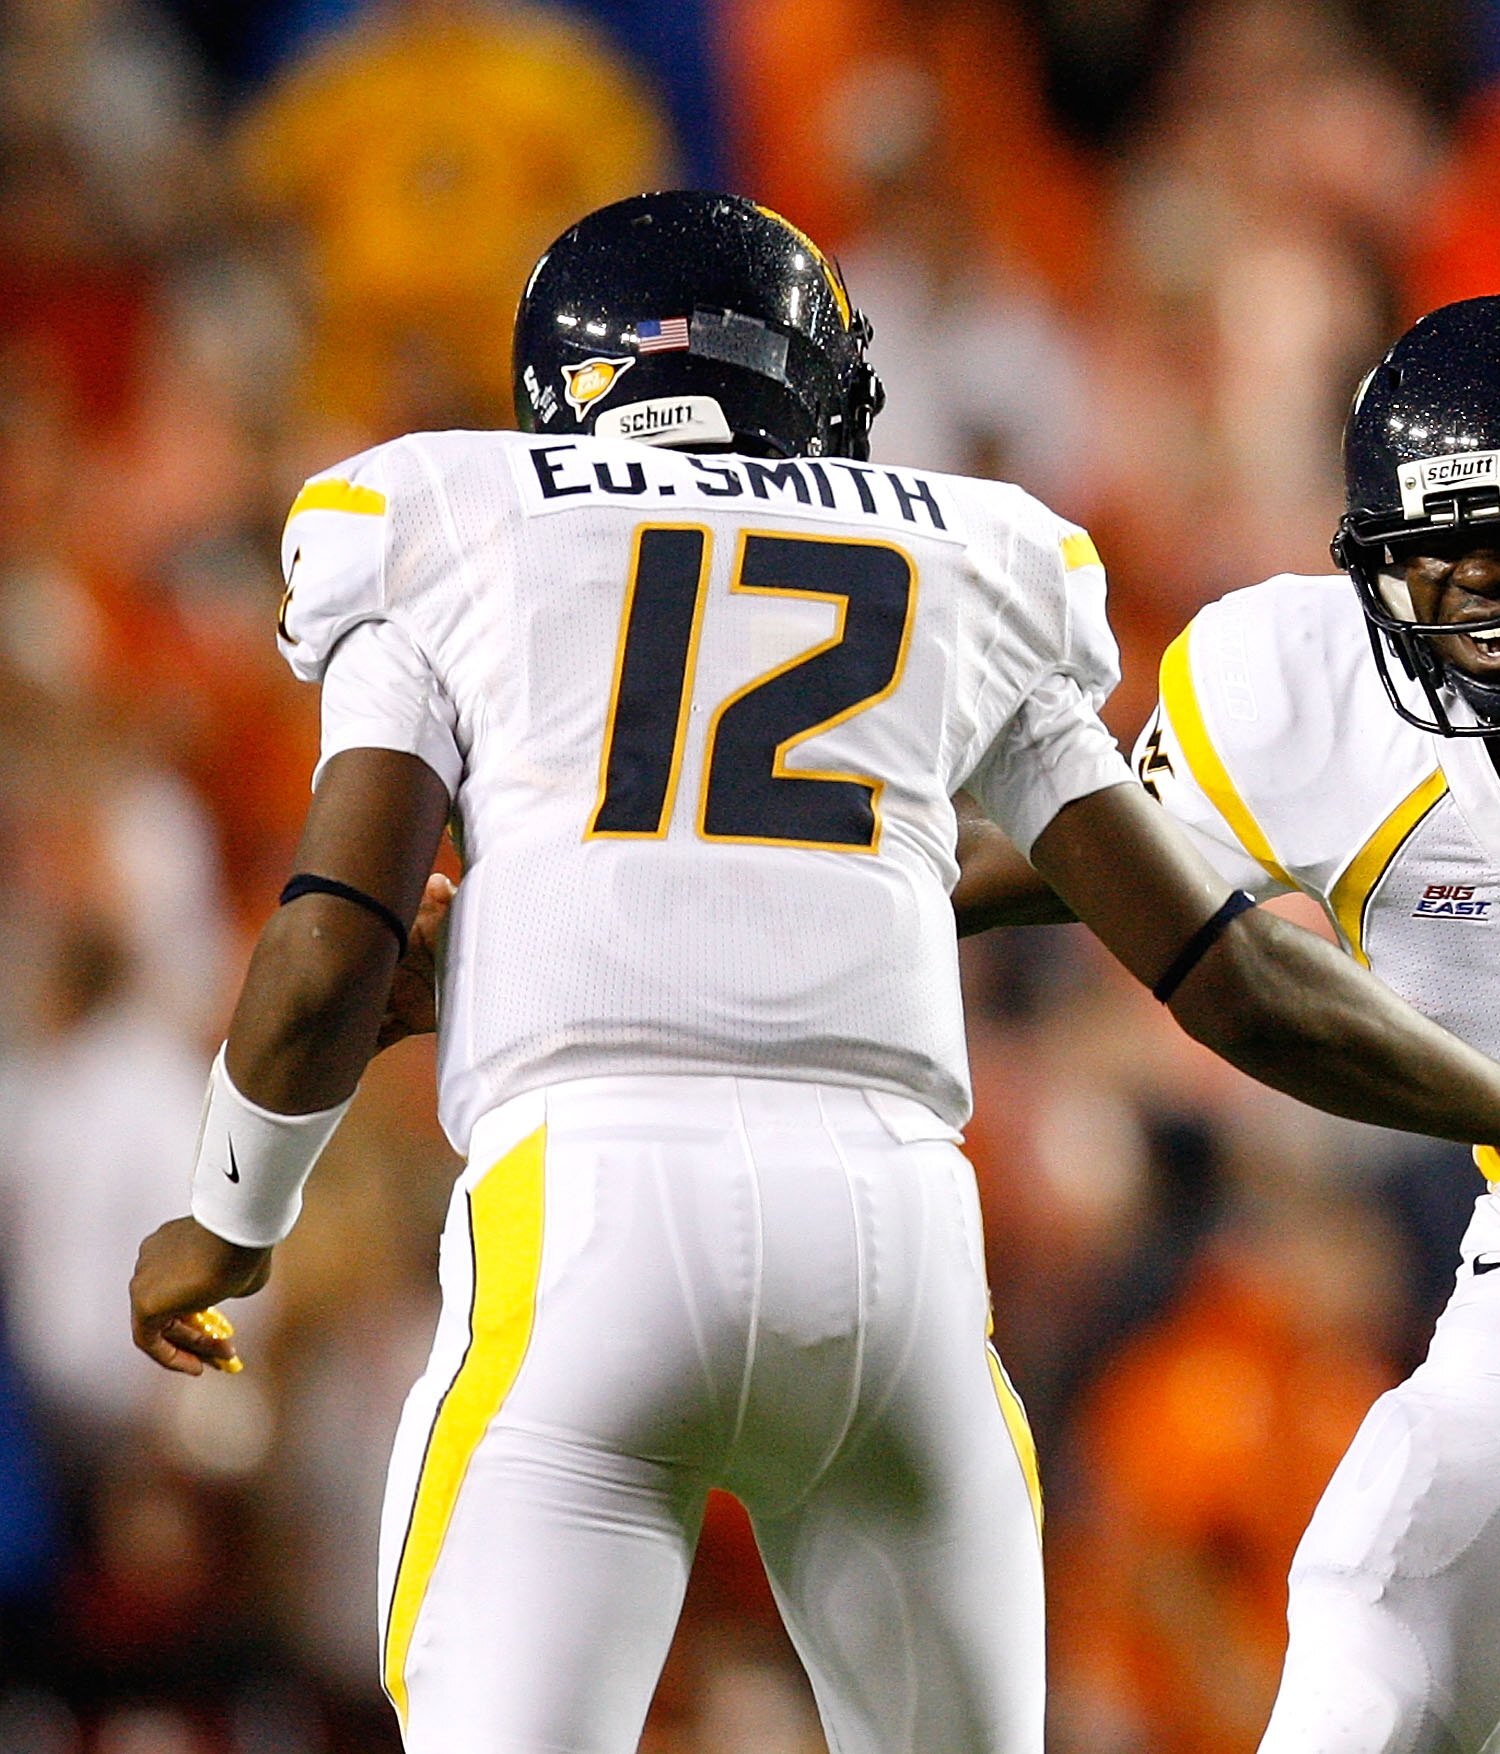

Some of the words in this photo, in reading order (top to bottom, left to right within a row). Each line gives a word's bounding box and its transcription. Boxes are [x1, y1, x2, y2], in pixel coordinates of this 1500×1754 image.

[1426, 456, 1493, 481] schutt
[686, 457, 948, 531] SMITH
[582, 521, 919, 855] 12
[1422, 885, 1476, 901] BIG
[1415, 900, 1492, 916] EAST
